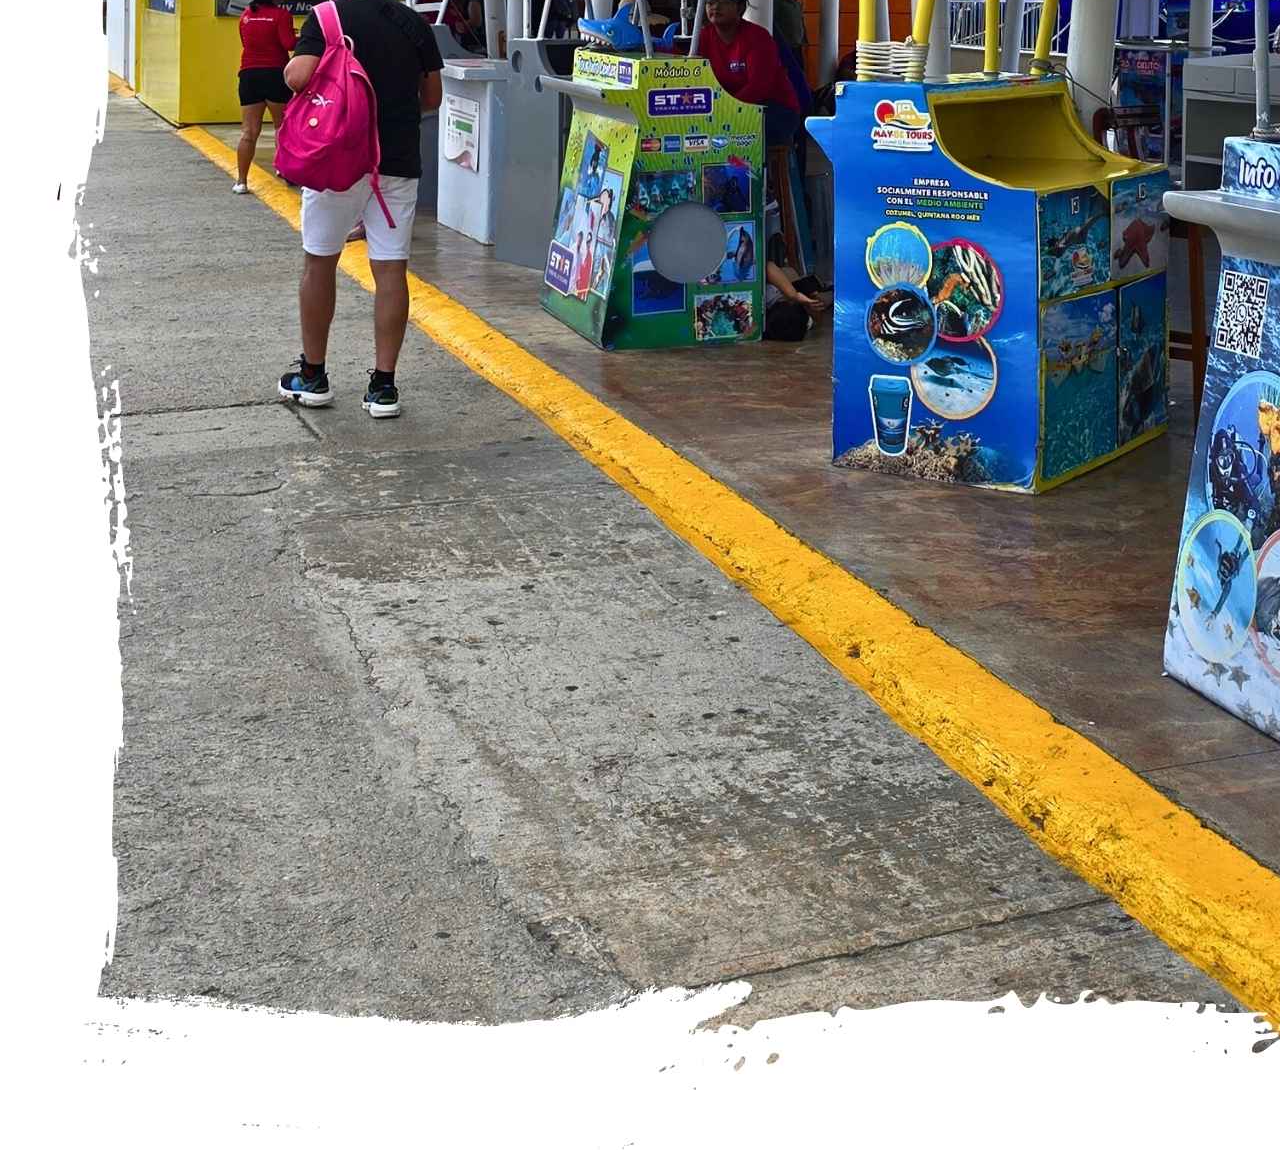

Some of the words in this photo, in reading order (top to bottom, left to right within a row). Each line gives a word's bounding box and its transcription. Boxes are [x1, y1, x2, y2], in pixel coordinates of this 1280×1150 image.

[656, 67, 690, 78] Módulo
[694, 67, 701, 77] 6
[907, 131, 933, 140] TOURS
[1237, 157, 1275, 190] Info
[913, 179, 950, 187] EMPRESA
[877, 187, 931, 197] SOCIALMENTE
[932, 190, 988, 200] RESPONSABLE
[887, 197, 903, 205] CON
[944, 201, 985, 210] AMBIENTE
[918, 212, 950, 221] QUINTANA
